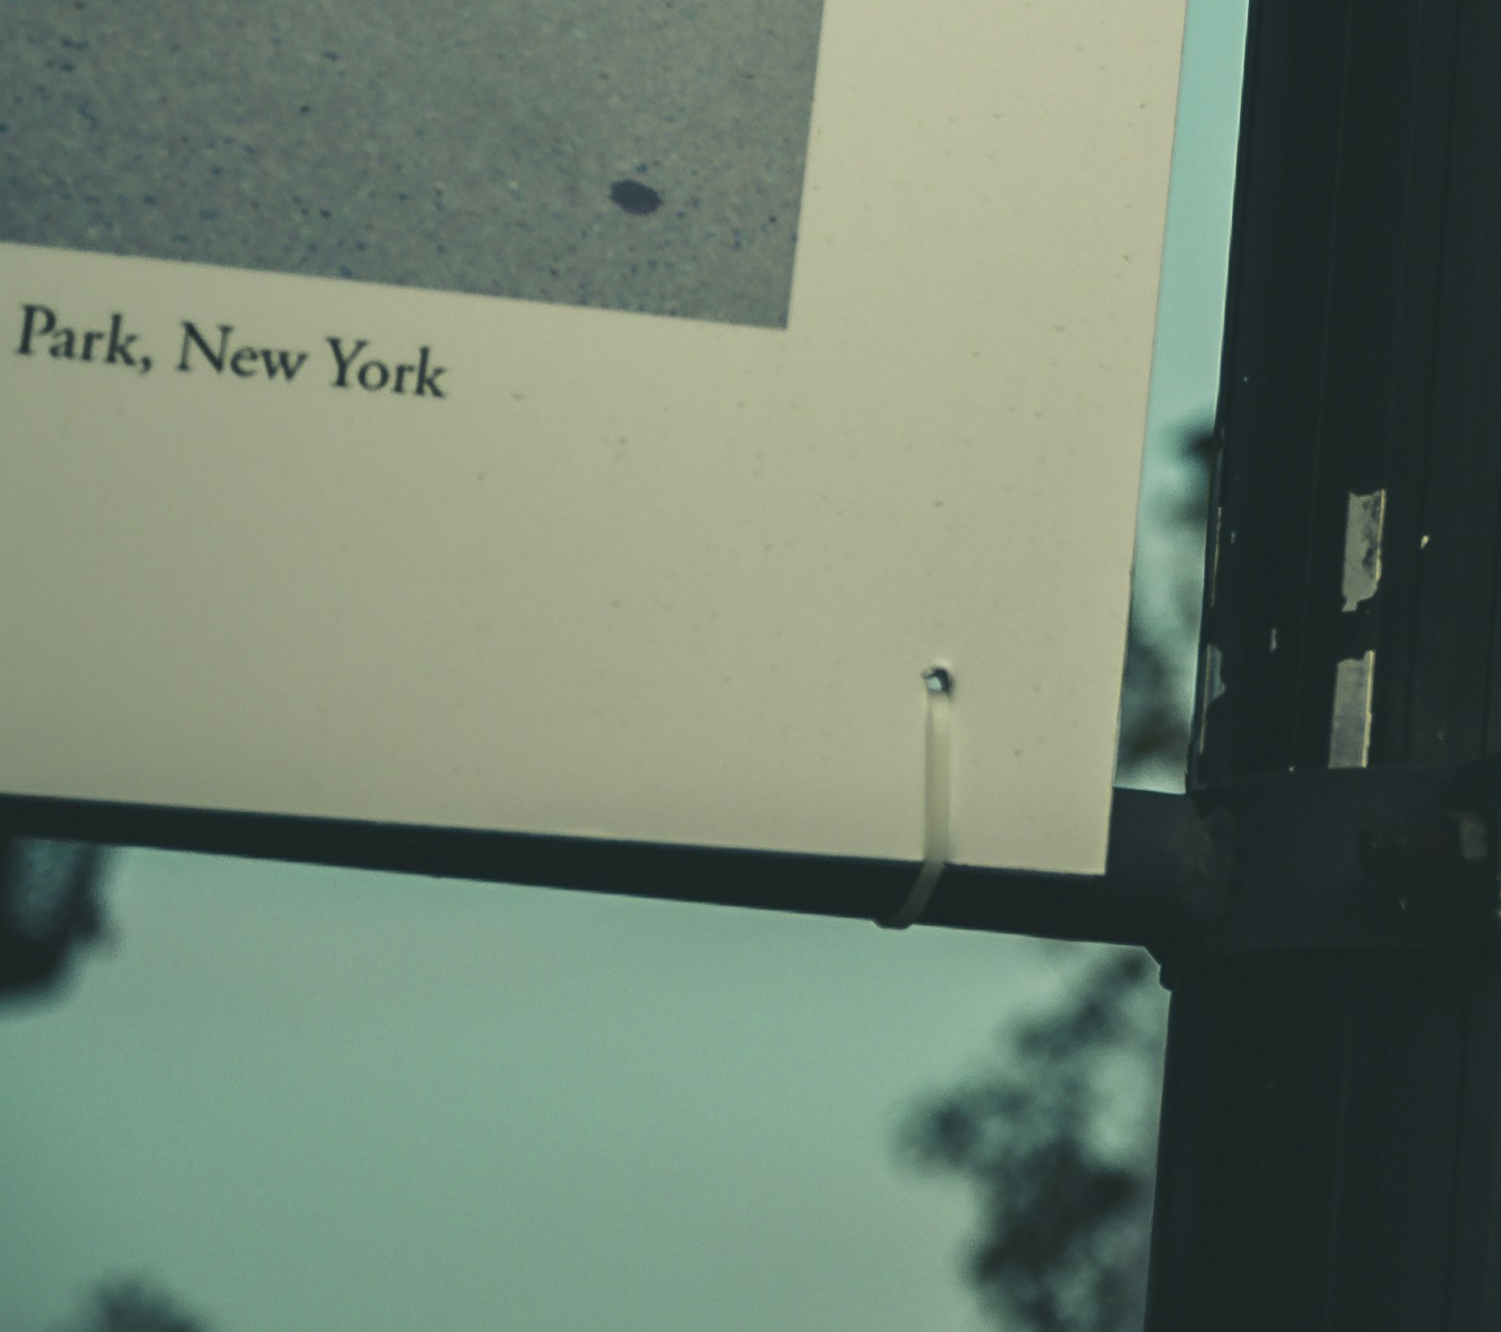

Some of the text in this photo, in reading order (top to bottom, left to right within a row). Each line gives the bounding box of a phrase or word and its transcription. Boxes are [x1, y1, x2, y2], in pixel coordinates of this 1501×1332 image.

[15, 303, 447, 400] Park, New York
